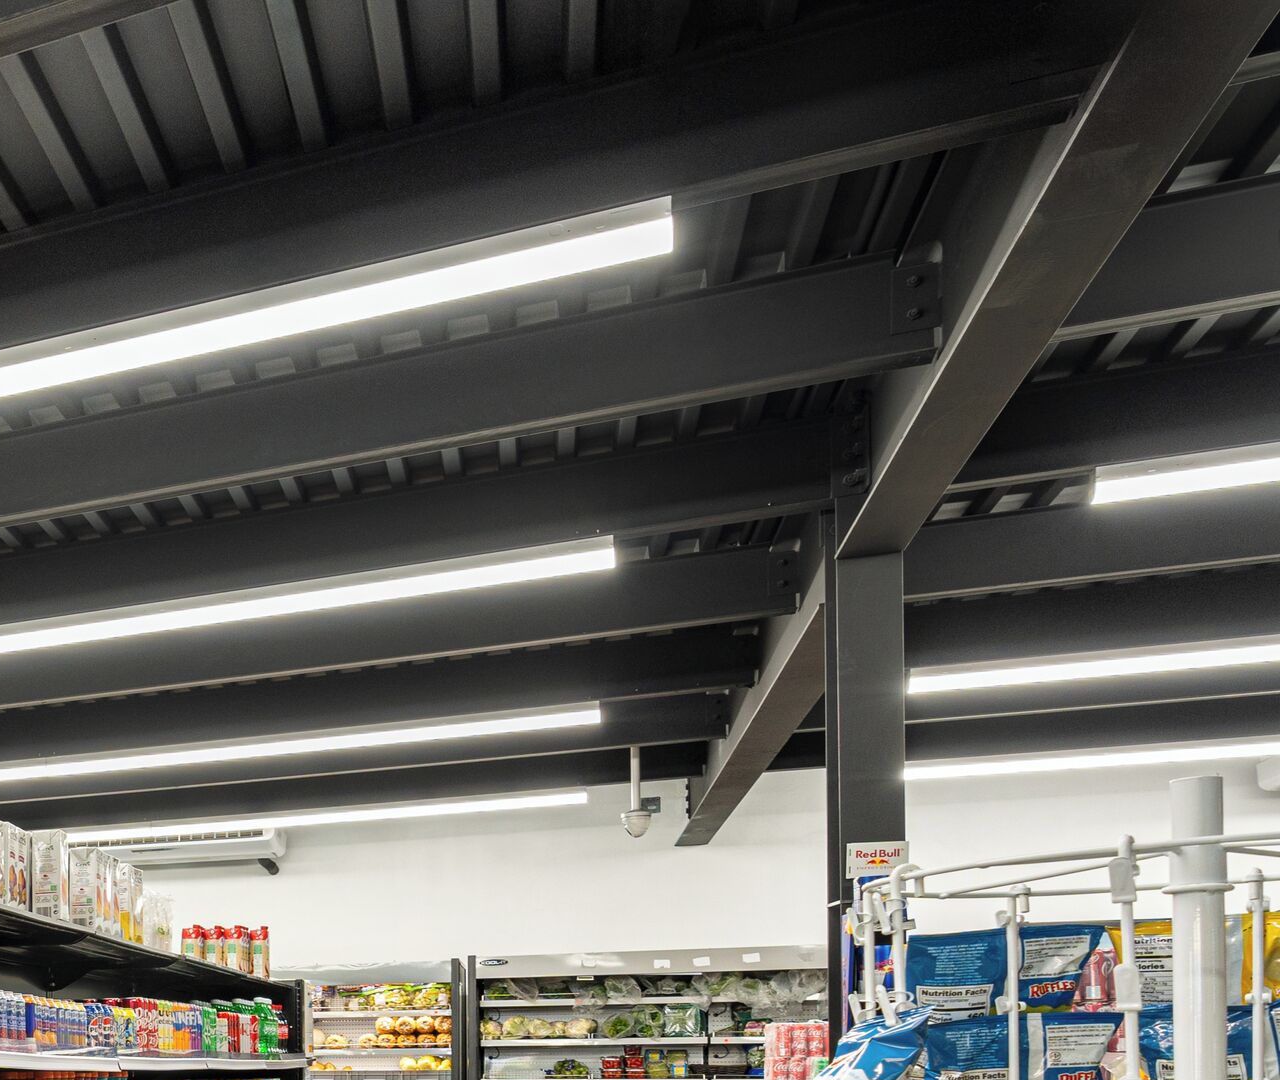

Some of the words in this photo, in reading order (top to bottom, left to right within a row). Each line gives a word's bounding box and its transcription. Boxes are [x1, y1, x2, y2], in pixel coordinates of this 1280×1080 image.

[856, 850, 877, 858] Red
[879, 849, 900, 857] Bull
[921, 989, 962, 997] Nutrition
[965, 988, 988, 996] Facts
[1030, 980, 1075, 998] RUFFLES
